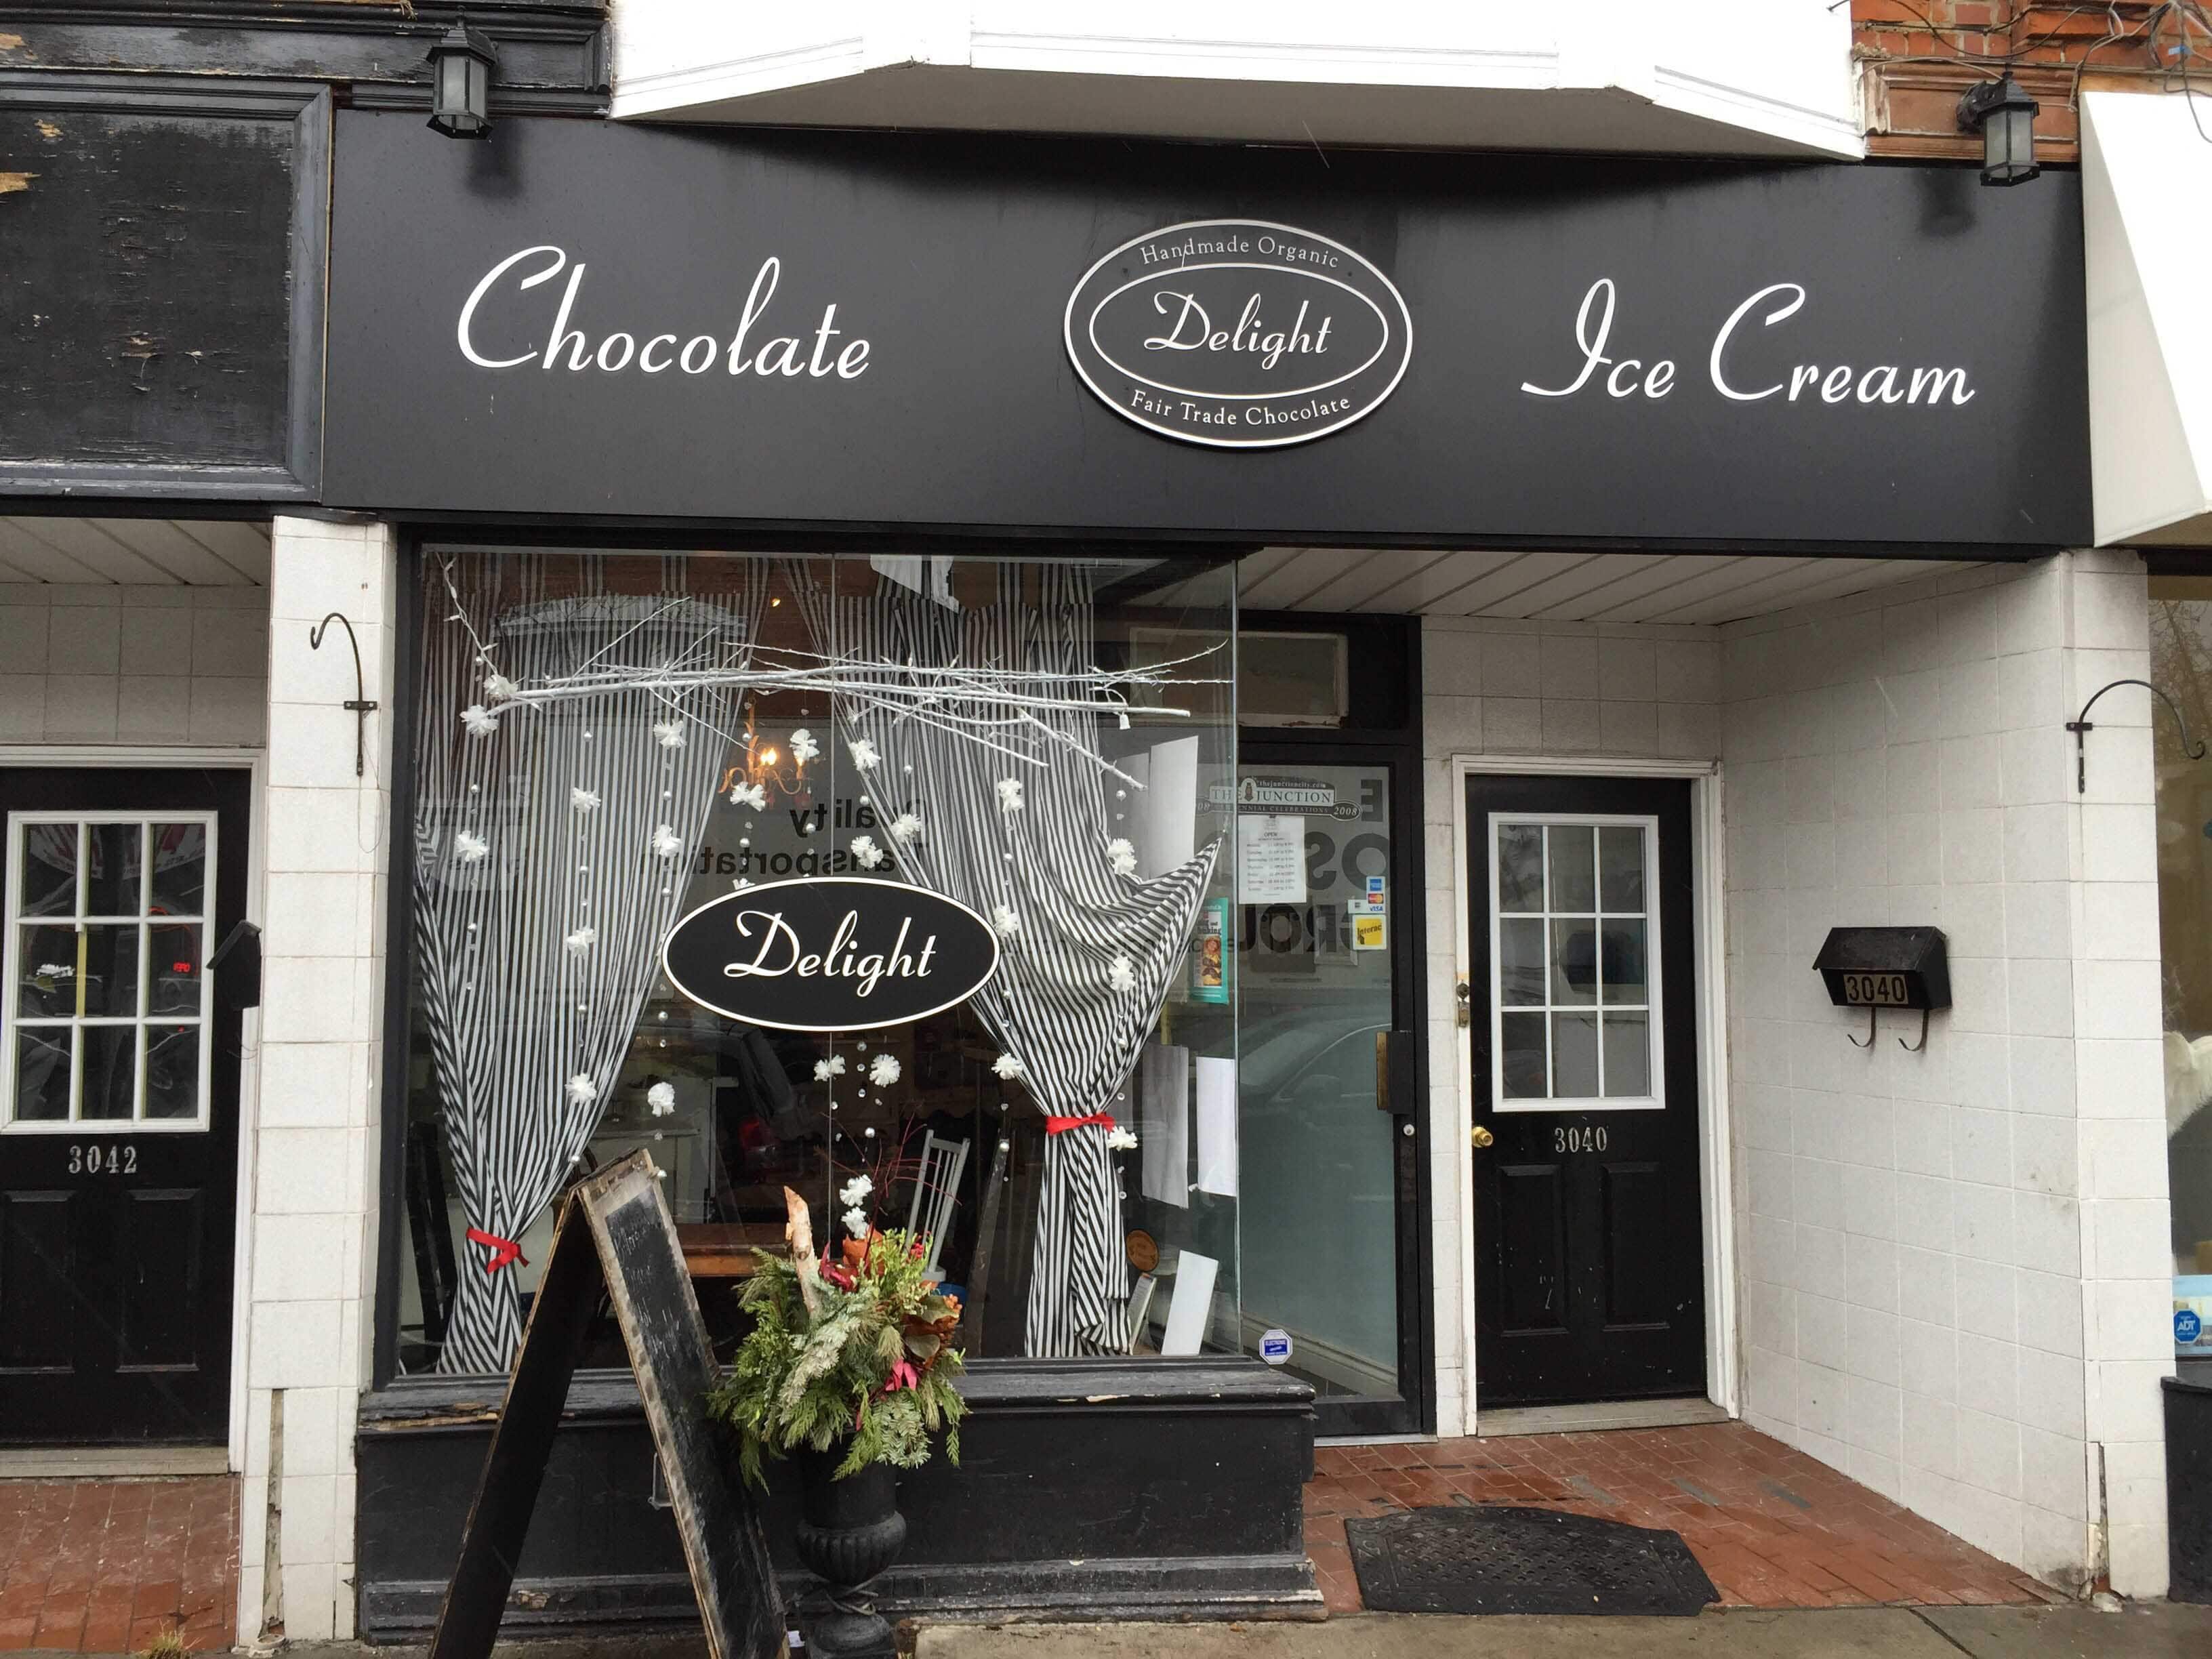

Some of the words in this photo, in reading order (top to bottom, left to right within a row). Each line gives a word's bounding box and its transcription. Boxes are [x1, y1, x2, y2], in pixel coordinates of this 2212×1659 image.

[1139, 234, 1250, 264] Handmade
[1258, 237, 1339, 268] Organic
[457, 245, 870, 380] Chocolate
[1143, 291, 1332, 370] Delight
[1520, 278, 1675, 398] Ice
[1710, 283, 1975, 405] Cream
[1130, 389, 1172, 417] Fair
[1181, 401, 1237, 426] Trade
[1246, 396, 1351, 426] Chocolate
[1256, 790, 1331, 803] JUNCTION
[1333, 806, 1358, 816] 2008
[1357, 924, 1383, 935] Interac
[723, 909, 937, 998] Delight
[1846, 976, 1906, 1002] 3040
[1554, 1126, 1608, 1153] 3040
[68, 1145, 137, 1174] 3042
[2177, 1320, 2196, 1332] ADT
